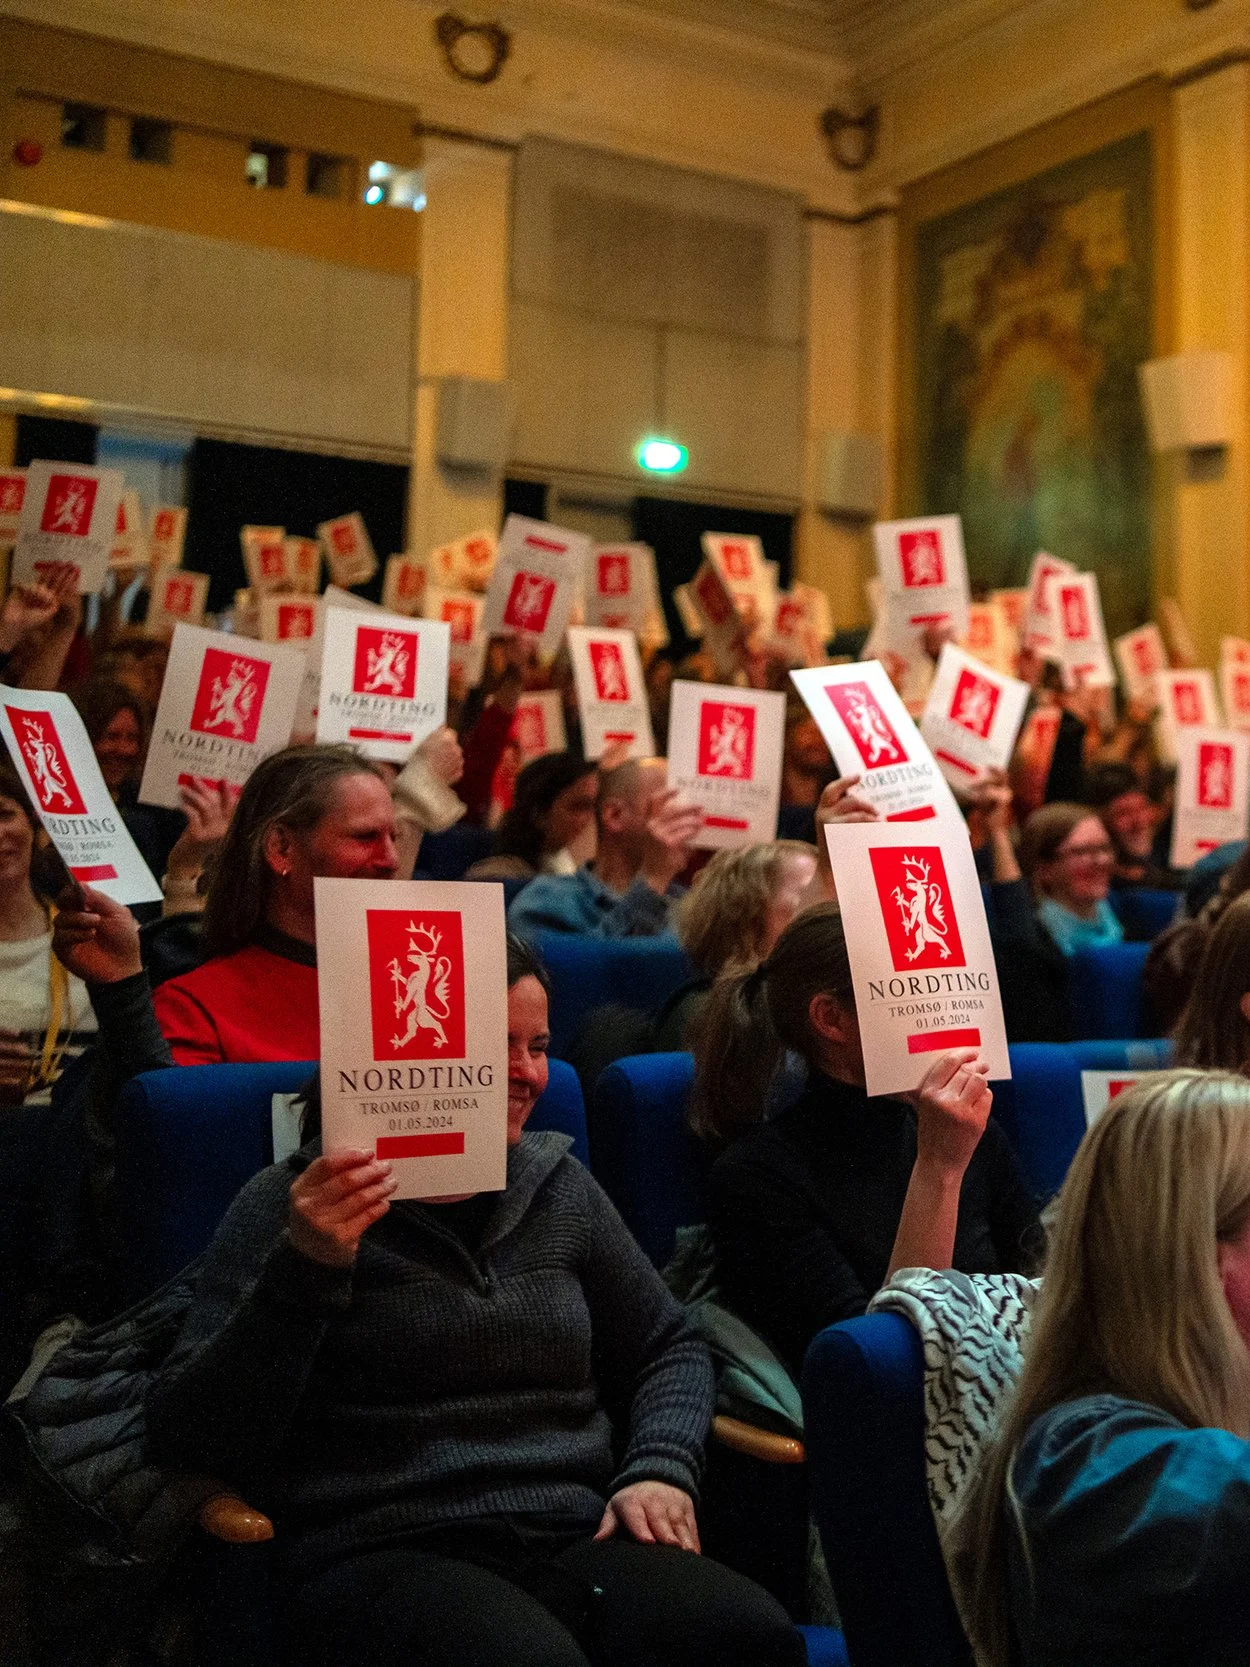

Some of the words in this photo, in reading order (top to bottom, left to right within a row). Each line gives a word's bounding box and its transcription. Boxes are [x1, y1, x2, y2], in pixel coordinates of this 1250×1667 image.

[162, 729, 268, 761] NORDTIN
[868, 972, 990, 1001] NORDTING
[888, 1003, 941, 1018] TROMSØ
[952, 1000, 985, 1011] ROMSA
[916, 1014, 971, 1029] 01.05.2024
[338, 1065, 494, 1092] NORDTING
[360, 1101, 420, 1115] TROMSØ
[433, 1098, 479, 1111] ROMSA
[389, 1116, 454, 1131] 01.05.2024
